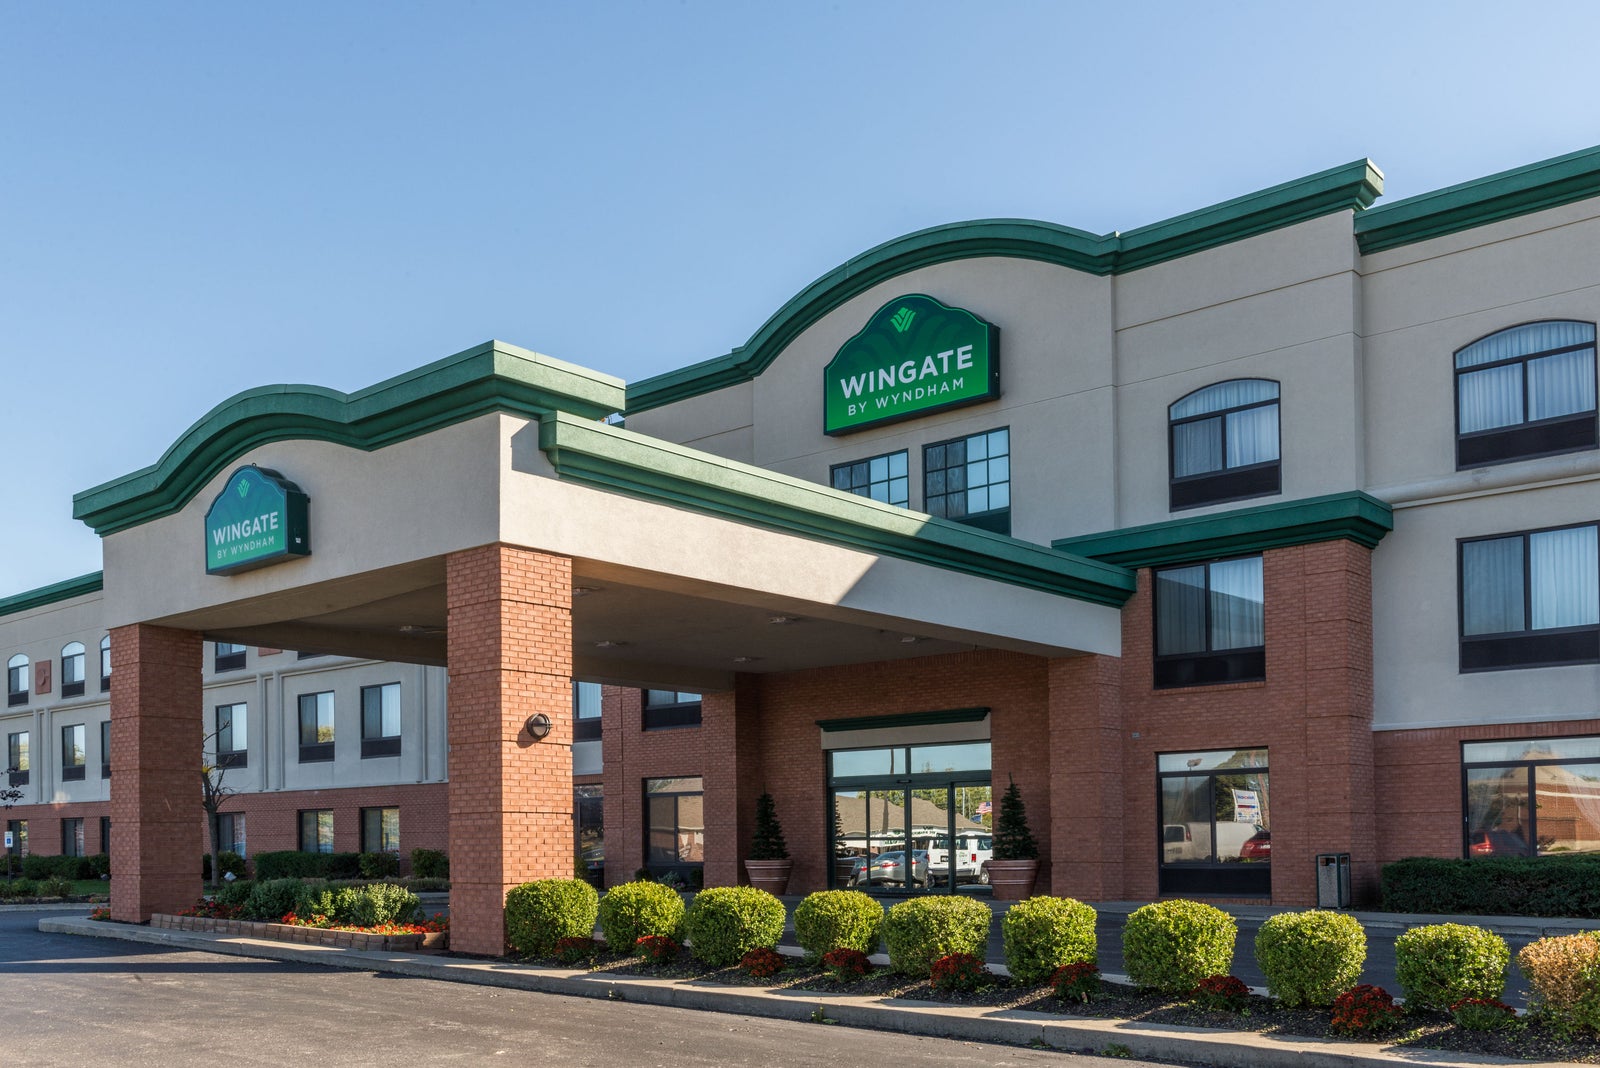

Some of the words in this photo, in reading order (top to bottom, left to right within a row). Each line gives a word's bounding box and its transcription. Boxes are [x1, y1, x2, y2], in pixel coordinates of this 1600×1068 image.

[840, 344, 973, 399] WINGATE
[848, 401, 867, 416] BY
[875, 377, 964, 409] WYNDHAM
[213, 511, 279, 546] WINGATE
[217, 548, 227, 559] BY
[230, 535, 275, 555] WYNDHAM
